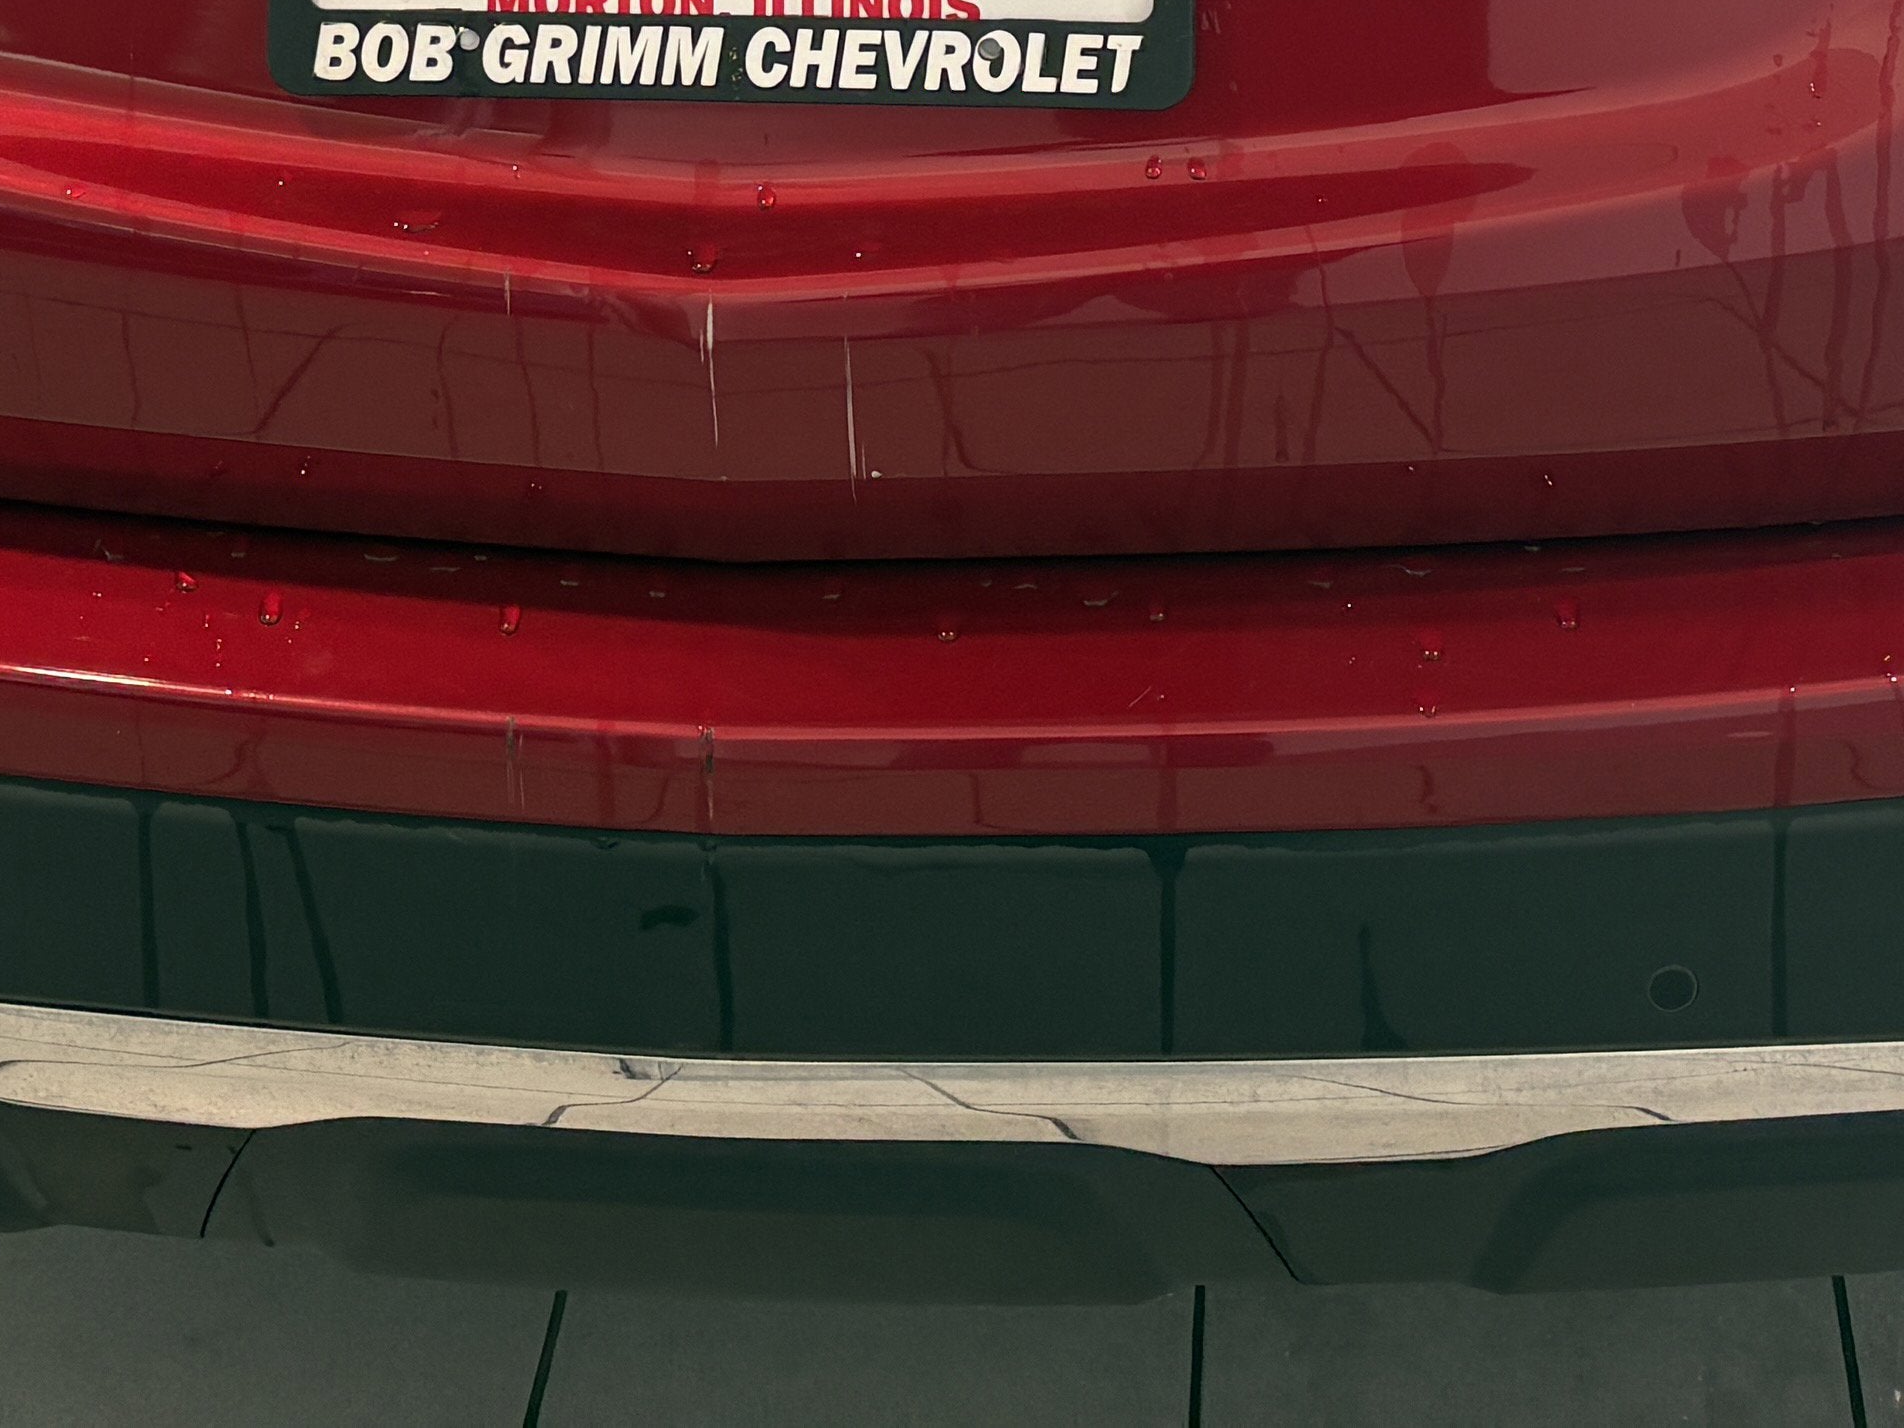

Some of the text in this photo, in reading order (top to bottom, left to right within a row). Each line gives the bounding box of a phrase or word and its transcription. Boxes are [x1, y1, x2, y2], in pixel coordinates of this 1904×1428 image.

[313, 22, 1144, 94] BOB GRIMM CHEVROLET
